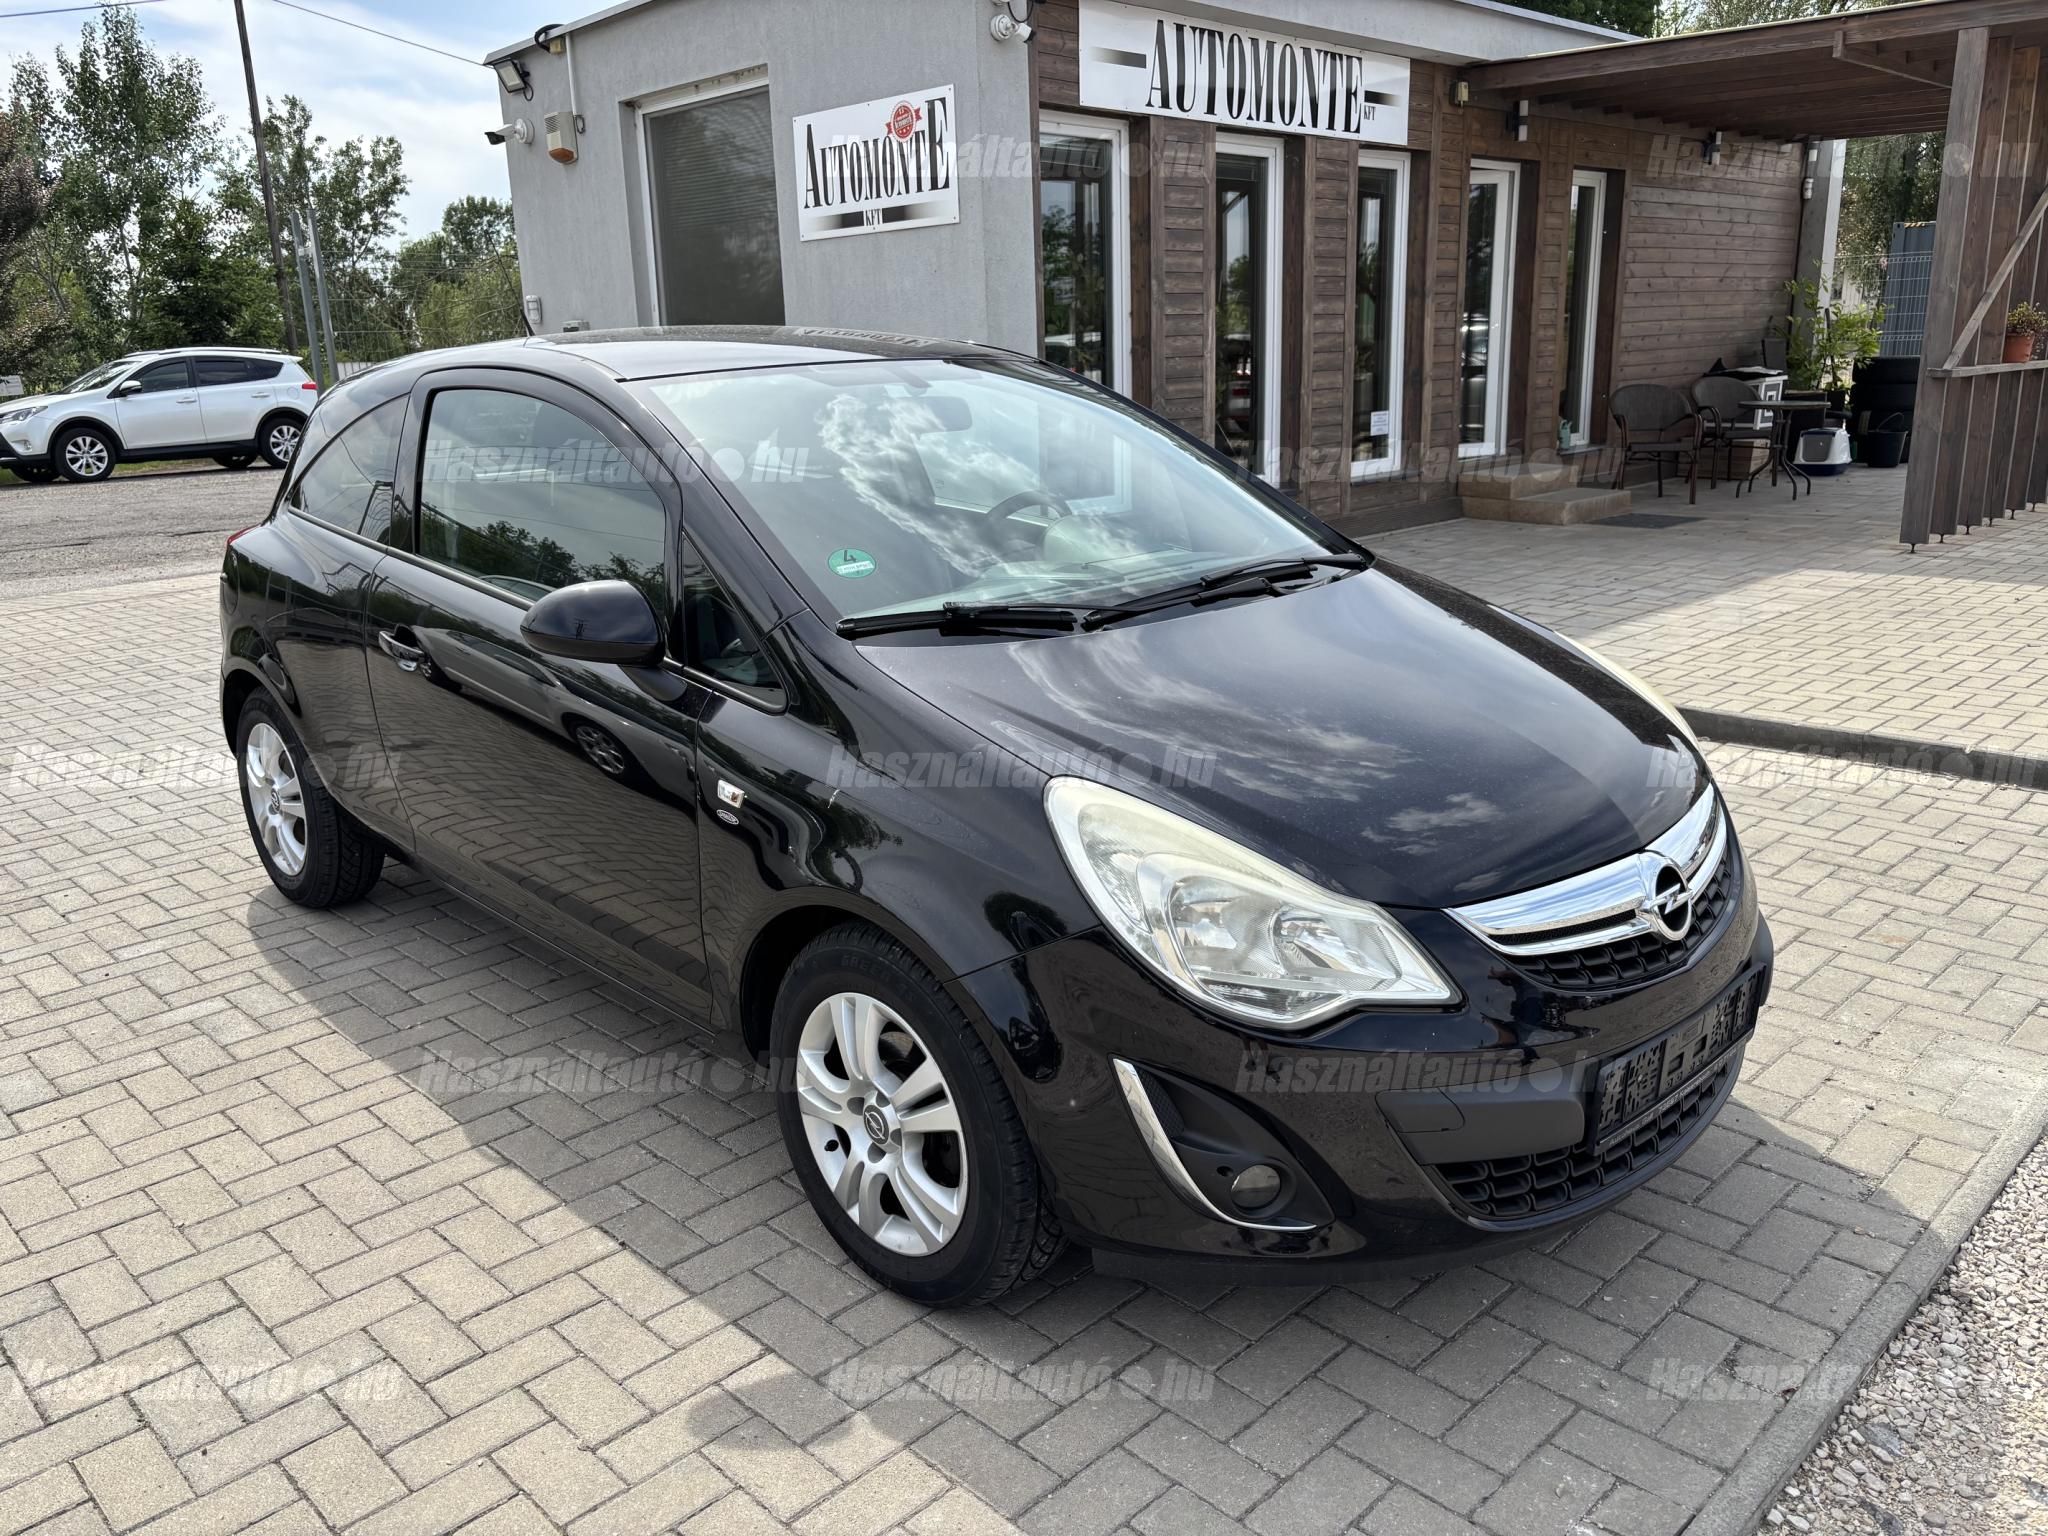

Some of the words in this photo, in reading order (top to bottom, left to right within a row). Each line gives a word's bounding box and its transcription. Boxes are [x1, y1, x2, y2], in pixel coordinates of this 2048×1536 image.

[1145, 19, 1363, 134] AUTOMONTE
[1363, 106, 1377, 121] KFT
[803, 97, 950, 209] AUTOMONTE
[864, 208, 882, 226] KFT
[844, 550, 857, 563] 4
